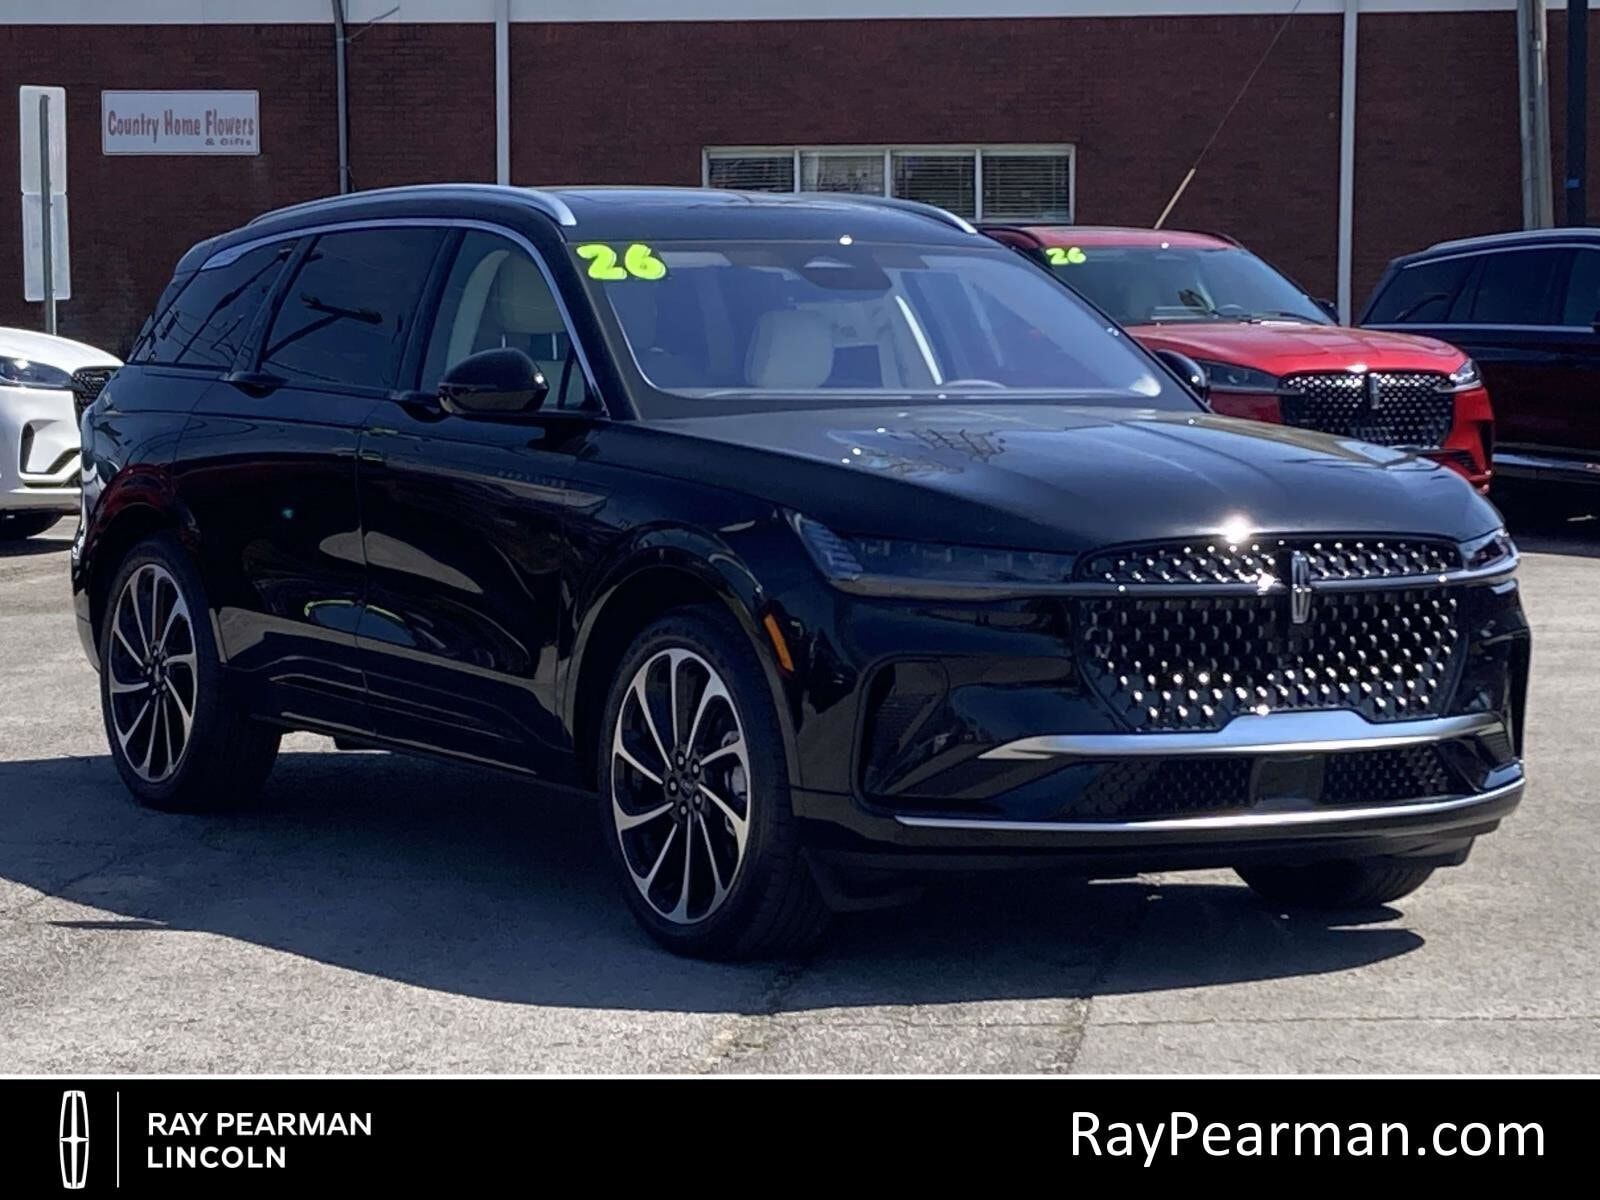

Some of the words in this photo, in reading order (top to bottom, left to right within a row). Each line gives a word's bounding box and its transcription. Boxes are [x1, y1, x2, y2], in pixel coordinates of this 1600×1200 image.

[108, 110, 159, 144] Country
[164, 109, 200, 136] Home
[205, 109, 254, 136] Flowers
[205, 138, 215, 146] &
[576, 244, 667, 280] 26
[1045, 246, 1087, 265] 26
